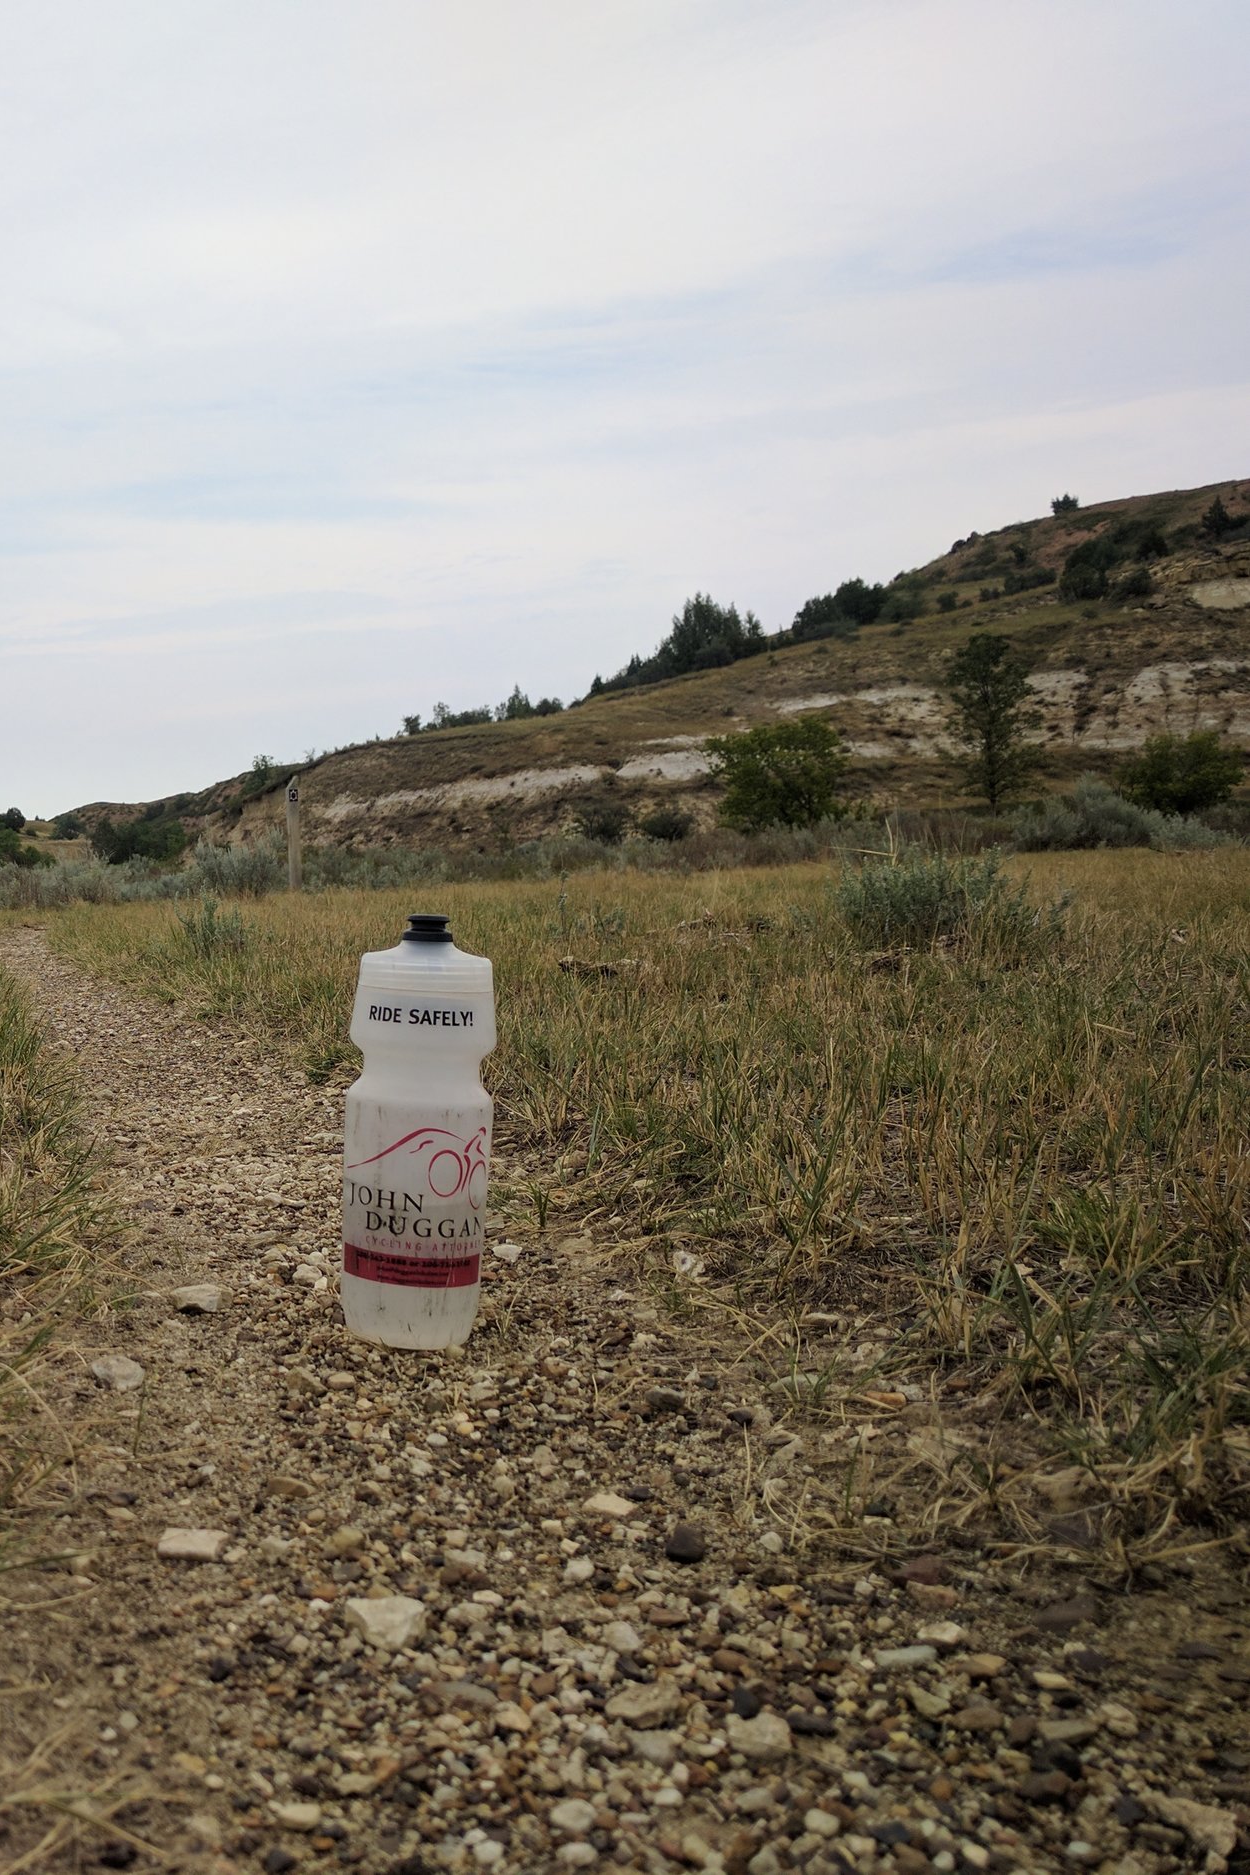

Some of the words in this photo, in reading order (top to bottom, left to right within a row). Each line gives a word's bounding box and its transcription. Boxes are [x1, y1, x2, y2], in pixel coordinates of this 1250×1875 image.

[369, 1005, 402, 1023] RIDE
[408, 1008, 474, 1027] SAFELY!
[350, 1182, 424, 1213] JOHN
[365, 1211, 482, 1239] DUGGAN
[365, 1235, 422, 1252] CYCLING
